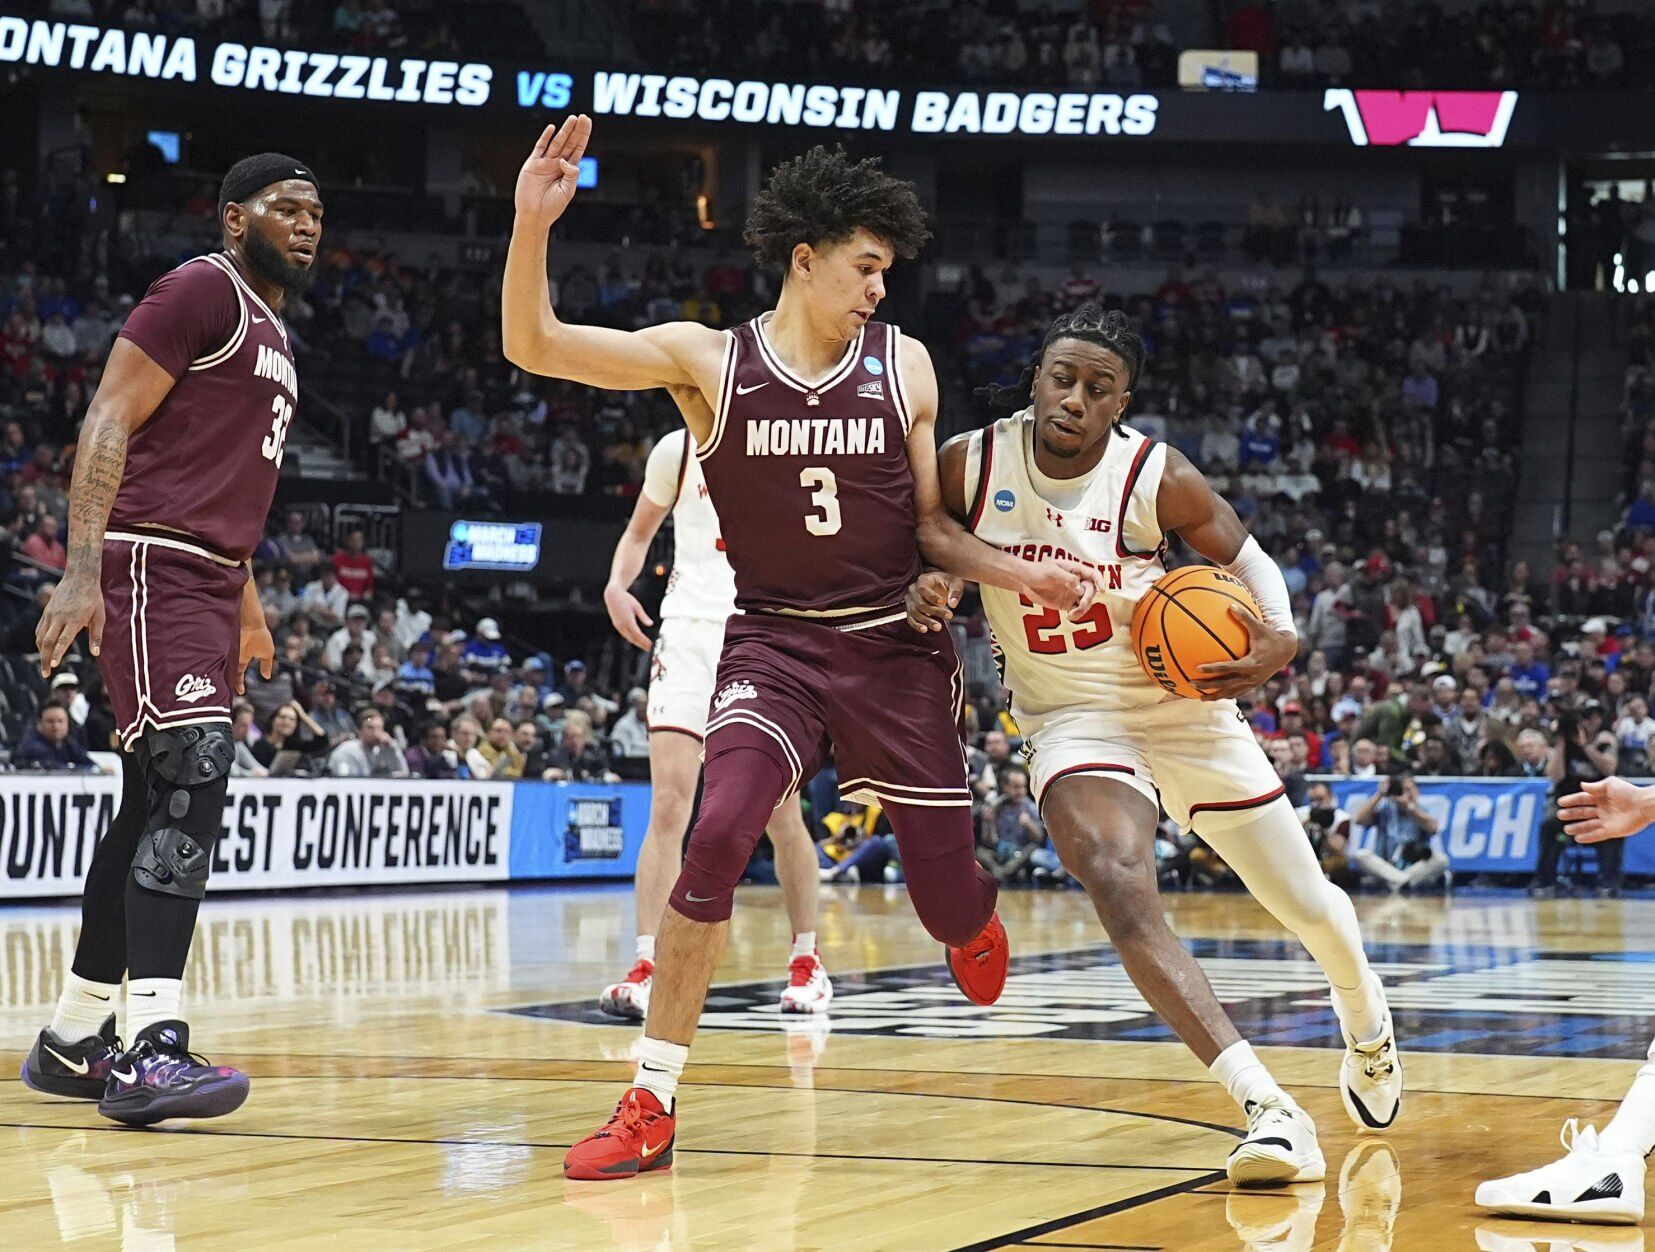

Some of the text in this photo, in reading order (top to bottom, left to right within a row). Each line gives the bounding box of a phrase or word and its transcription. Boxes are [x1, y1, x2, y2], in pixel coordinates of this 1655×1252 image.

[0, 16, 1159, 135] ONTANA GRIZZLIES VS WISCONSIN BADGERS
[254, 344, 298, 402] MONTA
[261, 393, 293, 470] 32
[746, 417, 885, 456] MONTANA
[799, 467, 843, 537] 3
[995, 499, 1014, 508] NCAA
[1018, 590, 1115, 655] 25
[175, 673, 217, 702] Griz
[211, 793, 281, 873] EST
[293, 794, 500, 870] CONFERENCE
